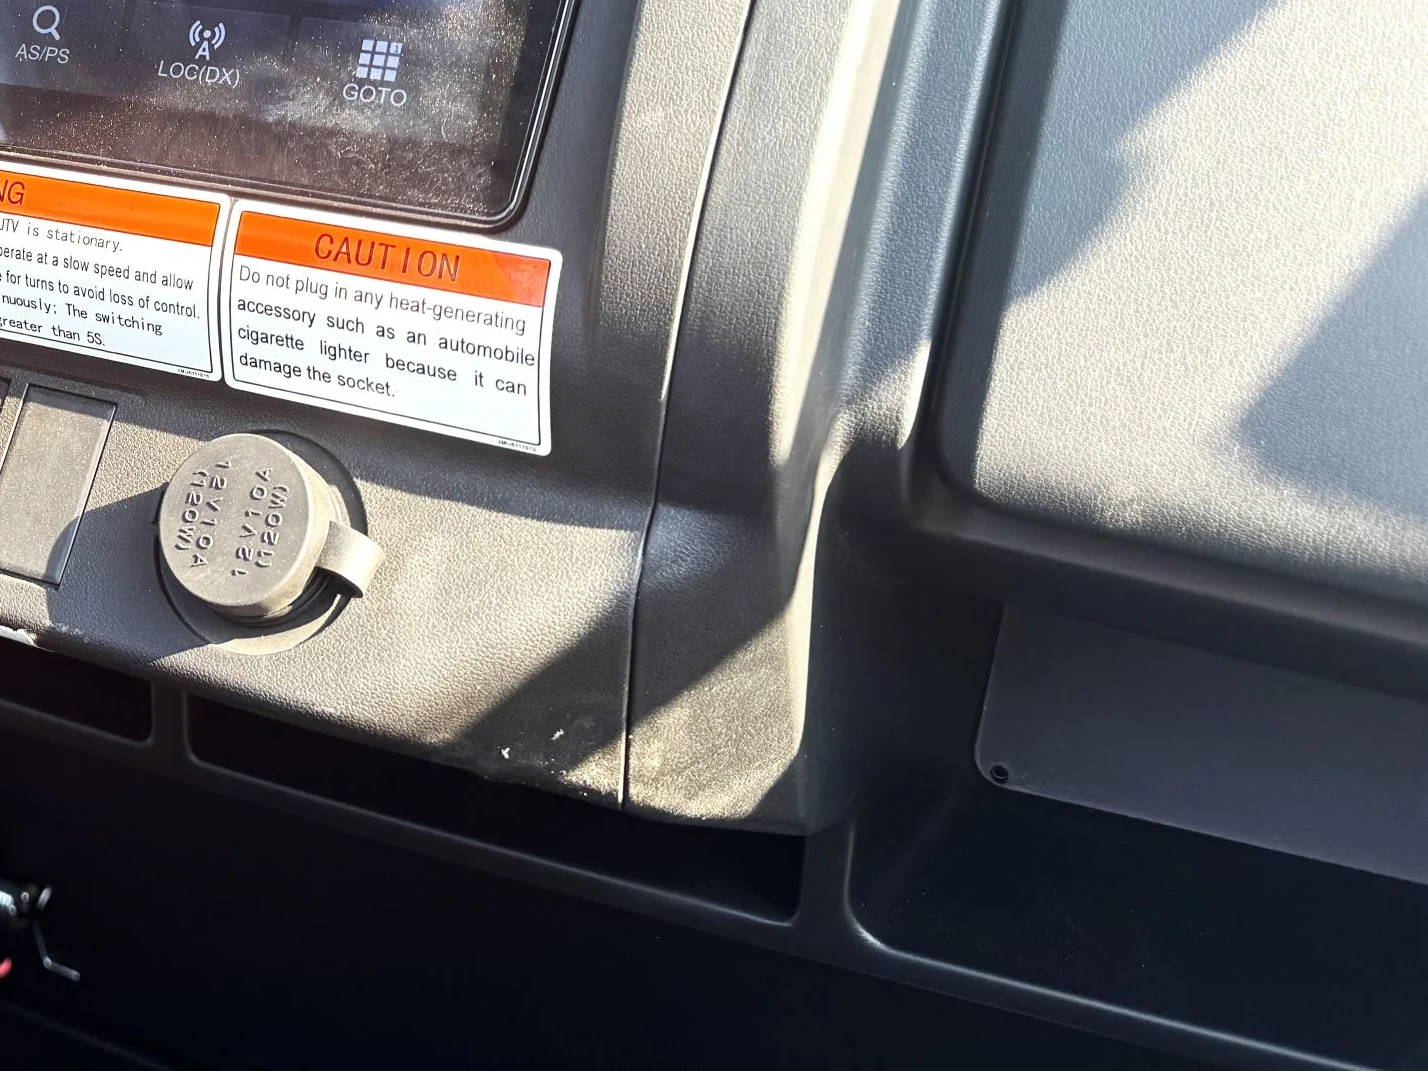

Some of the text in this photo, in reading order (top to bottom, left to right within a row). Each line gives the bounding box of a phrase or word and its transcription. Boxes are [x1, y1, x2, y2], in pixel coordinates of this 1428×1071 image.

[15, 43, 71, 65] AS/PS
[158, 60, 241, 89] LOC(DX)
[342, 83, 408, 107] GOTO
[27, 222, 39, 237] is
[46, 228, 123, 253] stationary.
[314, 232, 461, 282] CAUTION
[36, 251, 49, 265] at
[63, 256, 90, 273] slow
[93, 261, 130, 281] speed
[134, 269, 157, 283] and
[161, 274, 194, 291] allow
[5, 269, 22, 286] for
[25, 276, 55, 292] turns
[58, 280, 70, 295] to
[73, 284, 105, 302] avoid
[109, 289, 134, 307] loss
[138, 296, 151, 311] of
[153, 300, 201, 320] control.
[239, 265, 526, 337] Do not plug in any heat-generating
[51, 324, 81, 342] than
[86, 330, 106, 347] 5S.
[65, 303, 89, 320] The
[95, 311, 163, 337] switching
[237, 297, 535, 367] accessory such as an automobile
[237, 325, 527, 397] cigarette lighter because it can
[239, 352, 396, 398] damage the socket.
